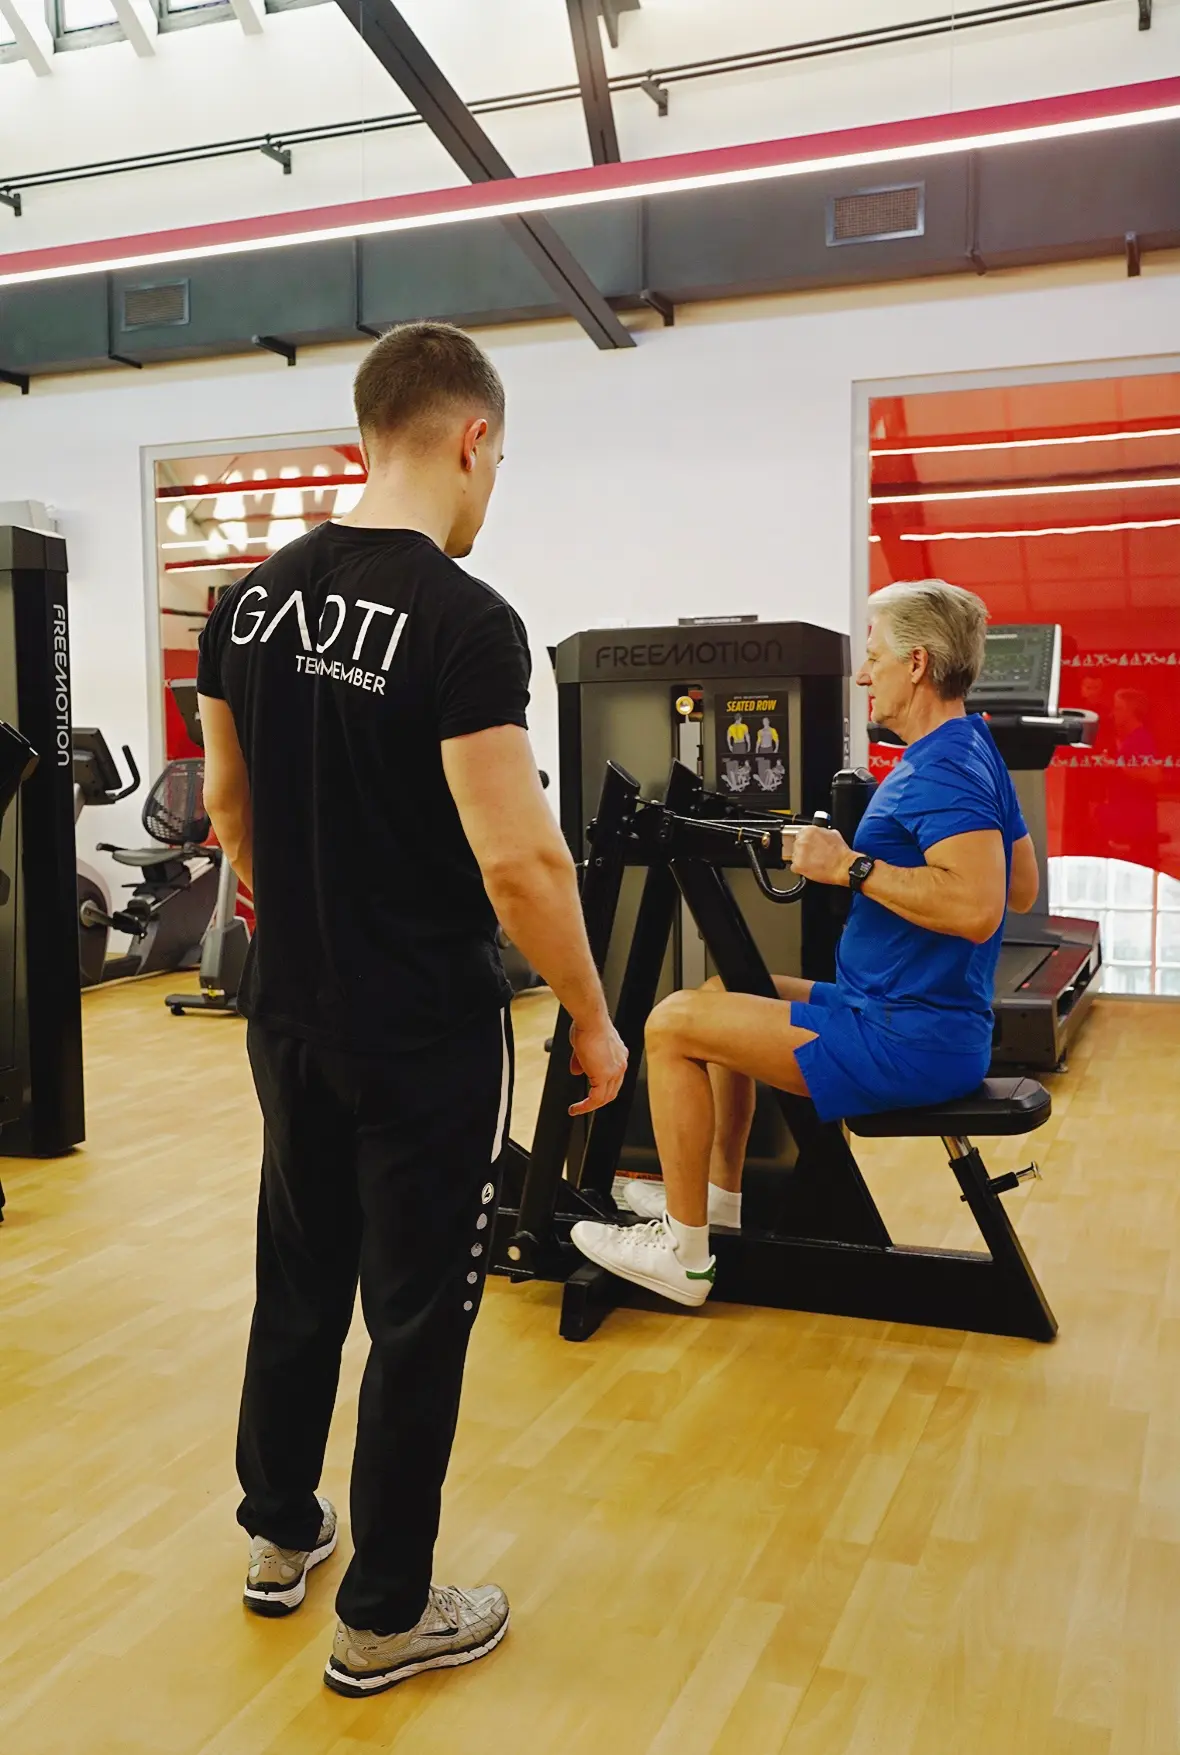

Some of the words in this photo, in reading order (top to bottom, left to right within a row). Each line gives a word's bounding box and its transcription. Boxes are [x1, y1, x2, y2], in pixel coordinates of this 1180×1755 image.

[596, 640, 782, 668] FREEMOTION
[53, 604, 70, 767] FREEMOTION
[726, 701, 755, 712] SEATED
[756, 700, 777, 711] ROW
